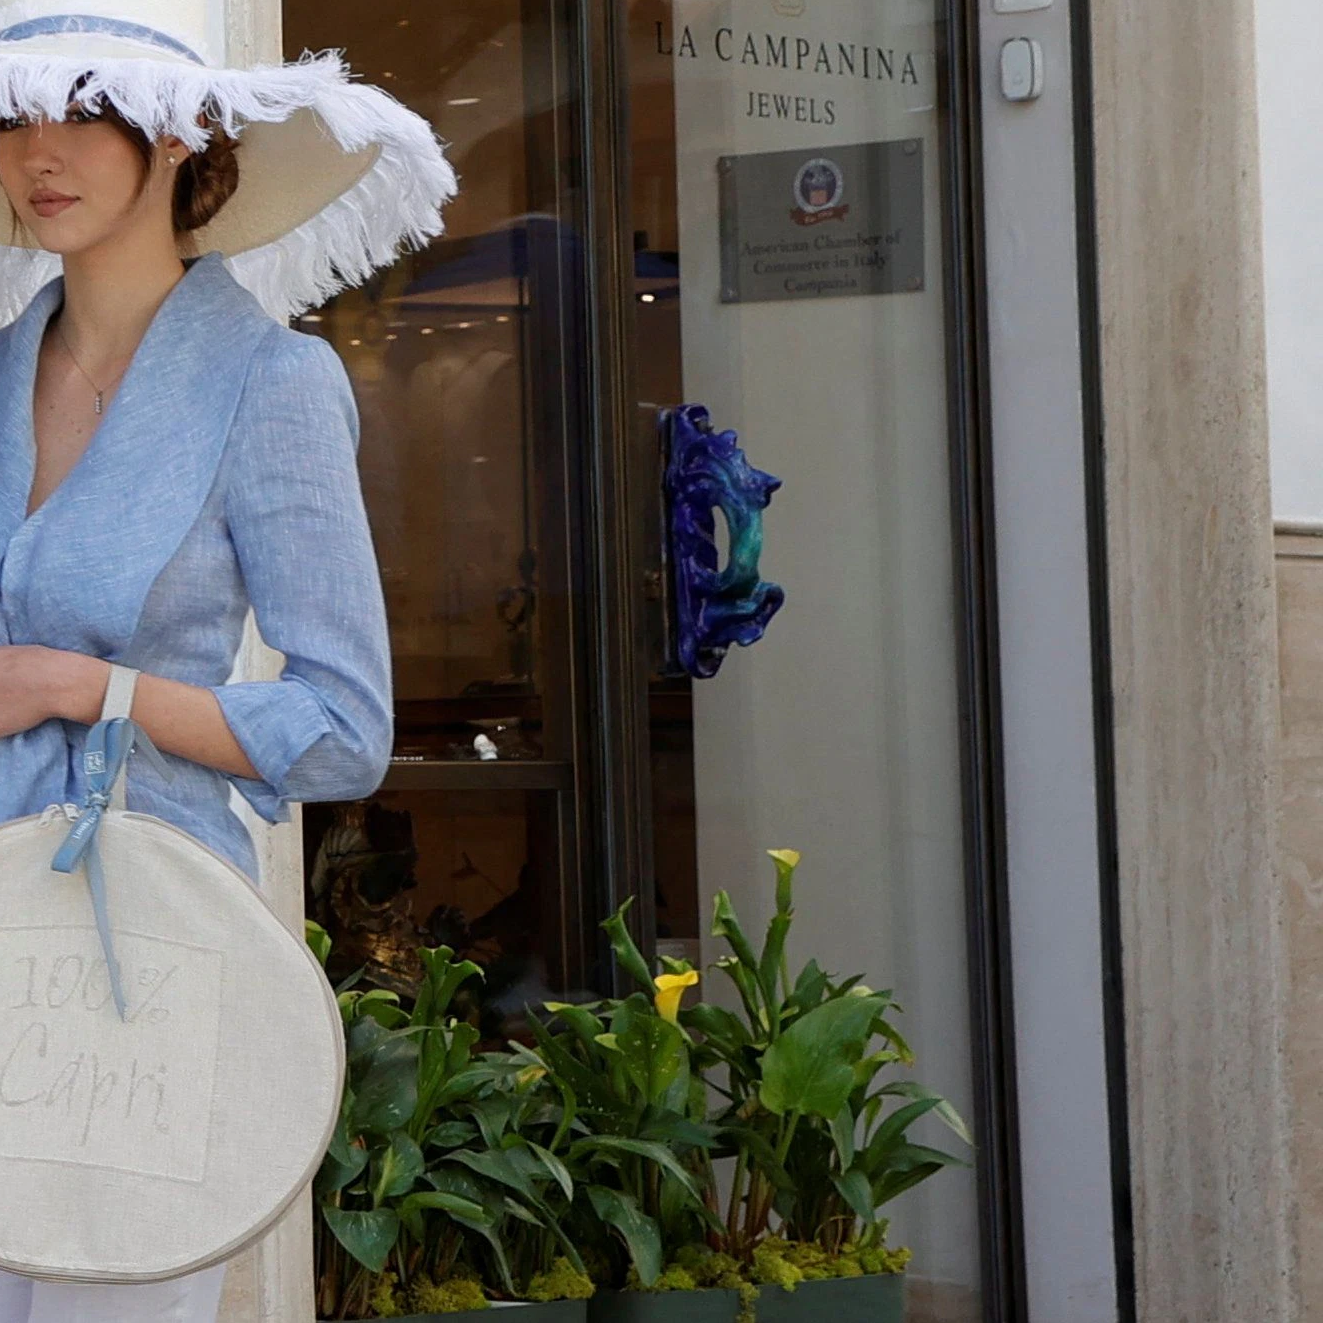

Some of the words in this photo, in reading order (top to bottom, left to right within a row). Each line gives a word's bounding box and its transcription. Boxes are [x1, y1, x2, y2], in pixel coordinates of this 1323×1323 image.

[654, 21, 697, 58] LA
[715, 27, 919, 85] CAMPANINA
[746, 92, 837, 125] JEWELS
[814, 232, 882, 250] Chamber
[854, 250, 887, 270] Italy
